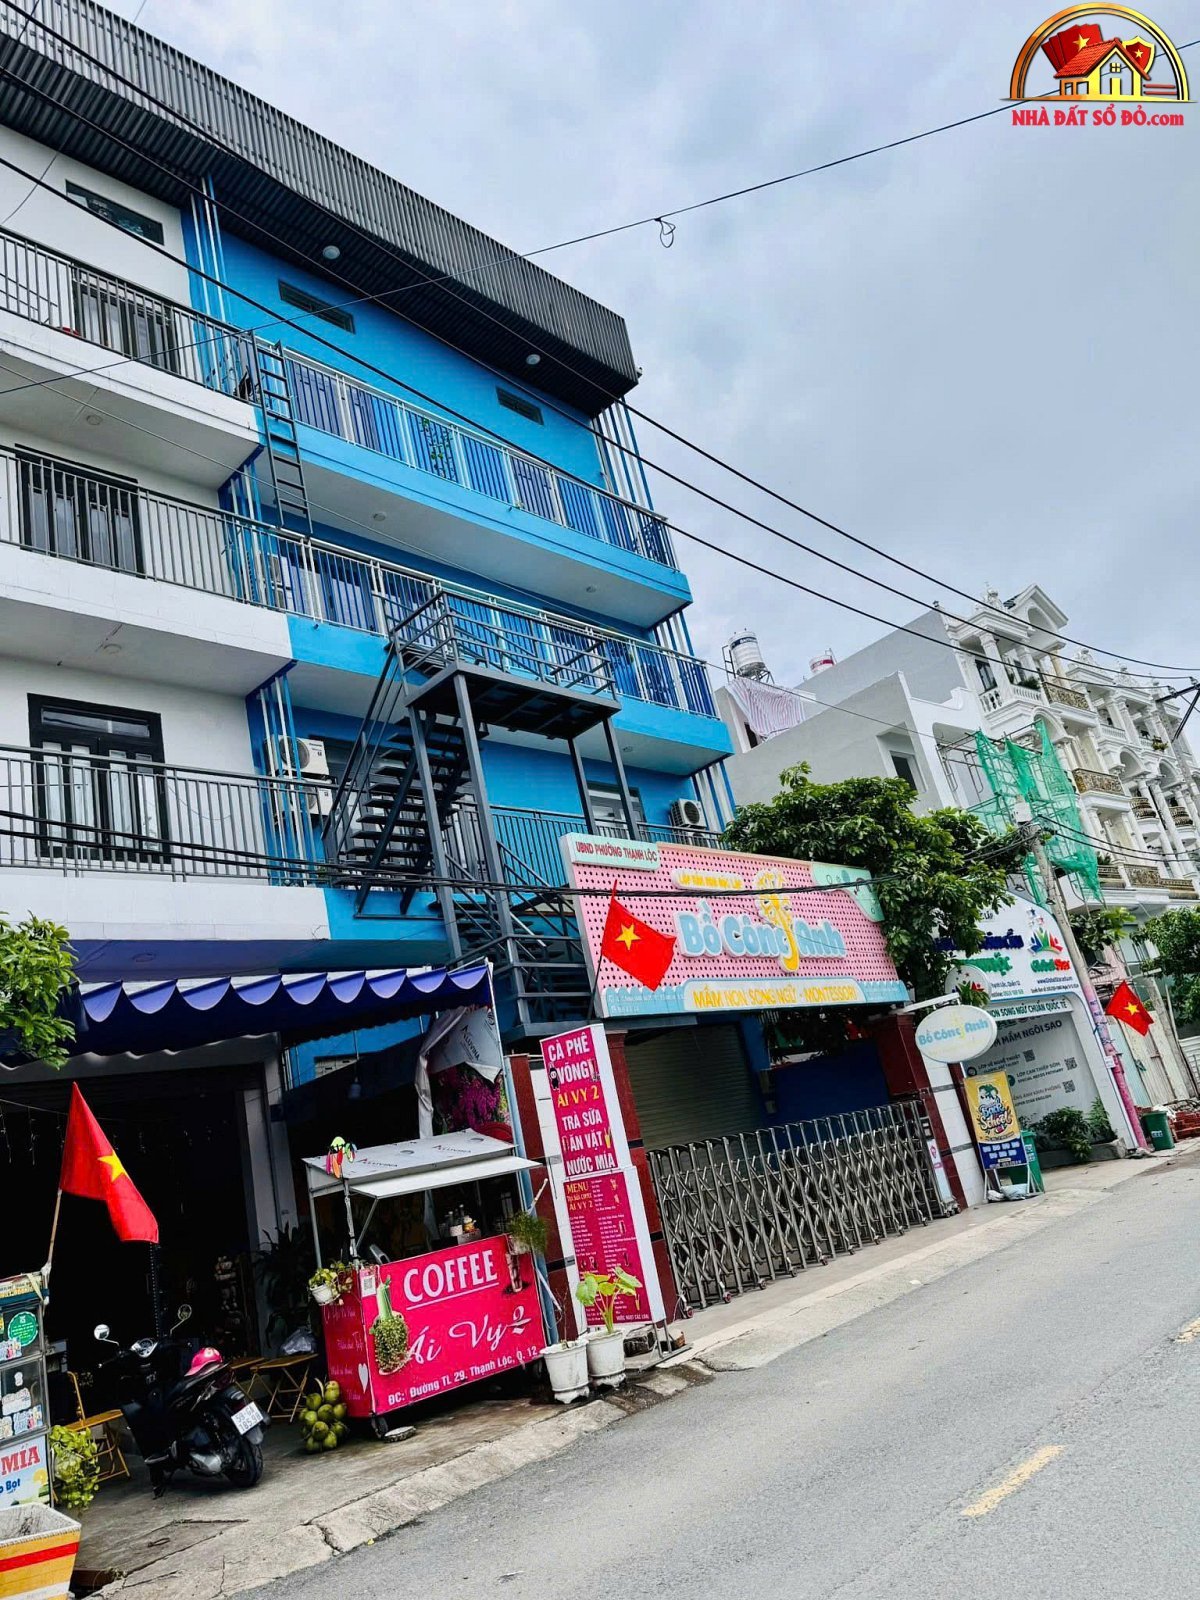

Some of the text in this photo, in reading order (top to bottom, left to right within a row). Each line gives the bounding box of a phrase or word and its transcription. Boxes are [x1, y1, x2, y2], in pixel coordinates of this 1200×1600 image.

[576, 842, 594, 855] UBND
[794, 916, 847, 957] Anh
[724, 990, 748, 1007] NON
[749, 988, 776, 1005] SONG
[804, 985, 858, 1003] MONTESSORI
[1001, 1004, 1016, 1016] SONG
[965, 1018, 988, 1033] Anh
[1022, 1024, 1044, 1037] NGÔI
[1044, 1020, 1062, 1031] SAO
[548, 1032, 591, 1062] CÀ PHÊ
[556, 1062, 590, 1085] VÕNG
[571, 1088, 588, 1104] VY
[591, 1084, 600, 1100] 2
[561, 1107, 604, 1131] TRÀ SỮA
[980, 1110, 1012, 1131] School
[570, 1130, 604, 1152] ĂN VẶT
[566, 1152, 616, 1176] NƯỚC MÍA
[566, 1181, 588, 1194] MENU
[579, 1201, 588, 1210] VY
[589, 1200, 594, 1208] 2
[403, 1249, 498, 1303] COFFEE
[407, 1325, 442, 1364] Ái
[448, 1314, 509, 1352] Vy
[511, 1305, 532, 1335] 2
[388, 1391, 405, 1406] ĐC:
[441, 1375, 452, 1386] TL
[470, 1359, 496, 1376] Thạnh
[527, 1345, 538, 1357] 12
